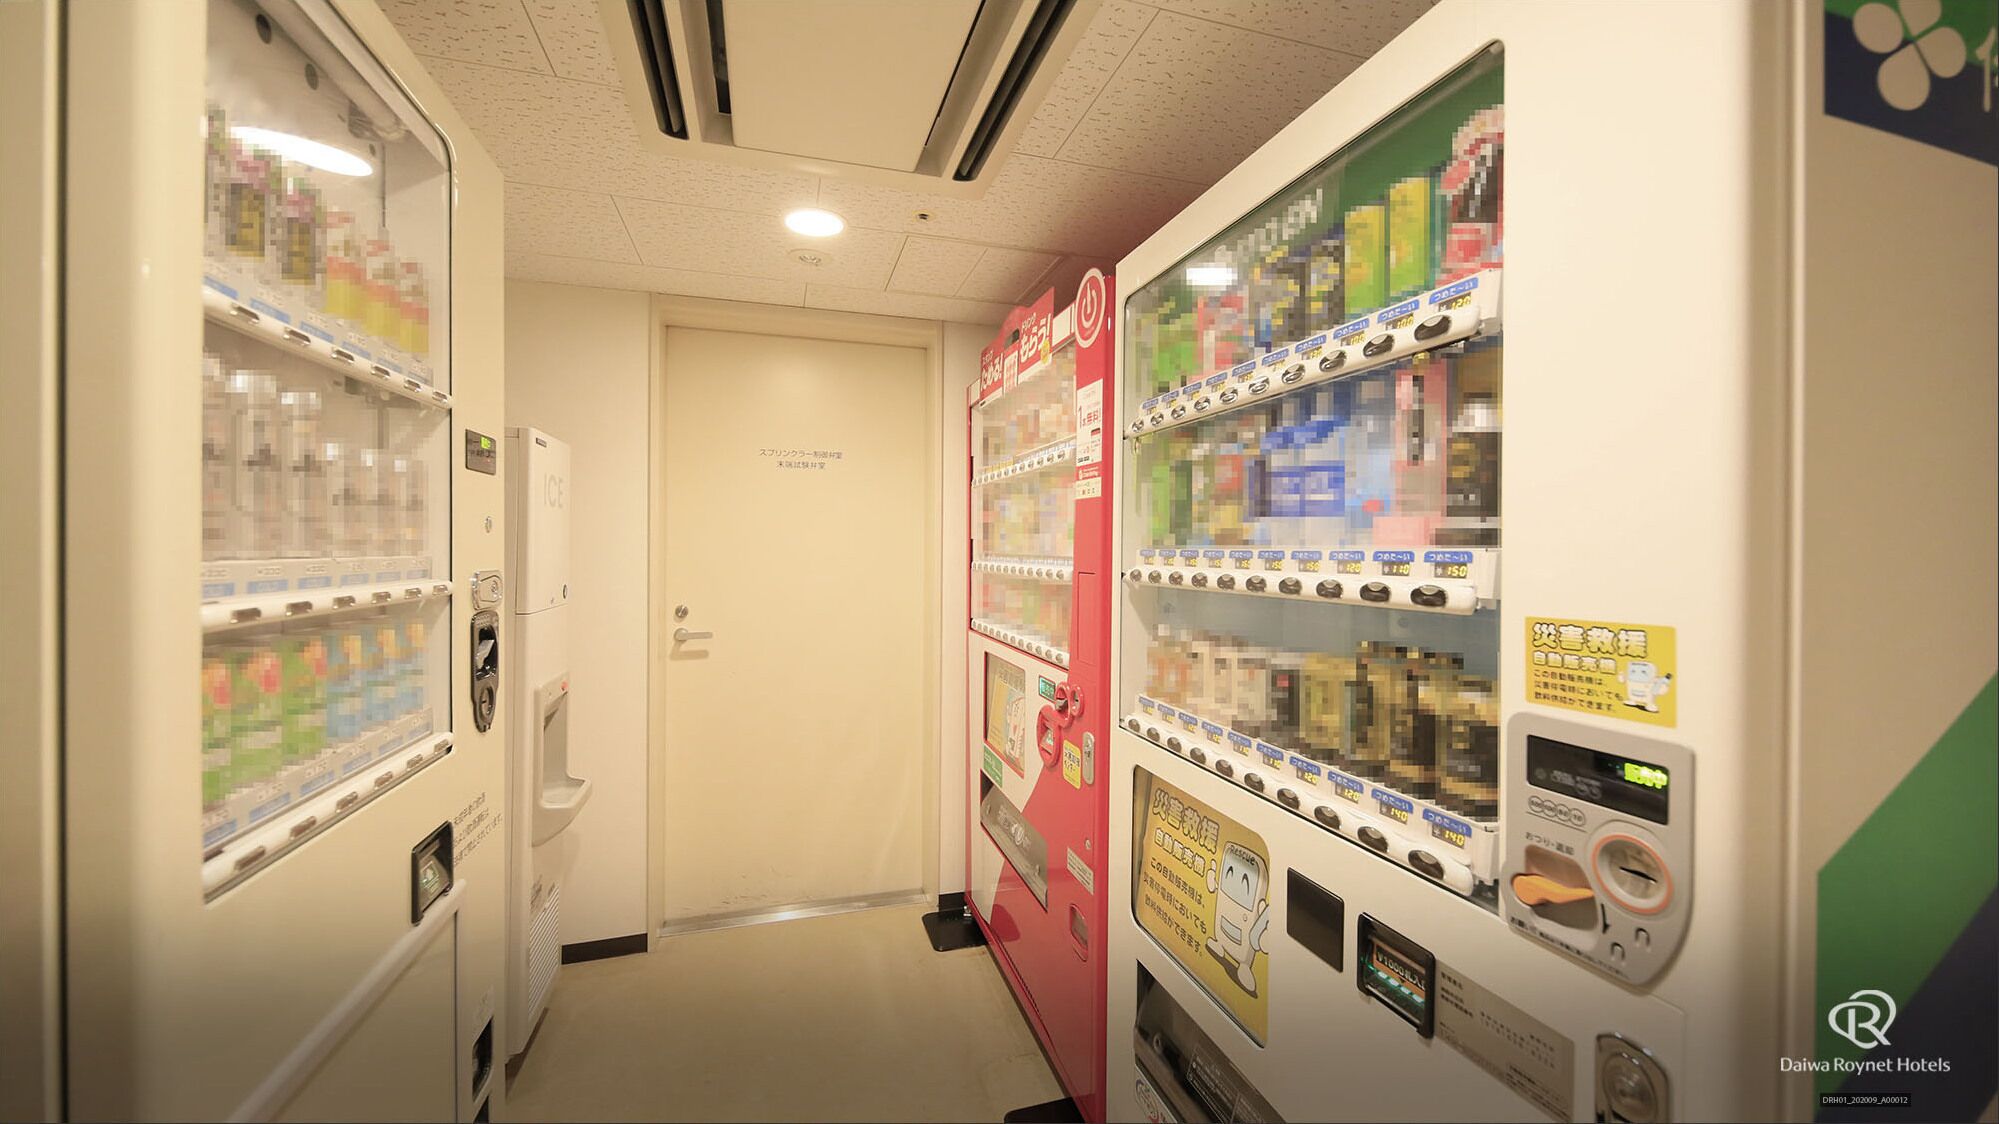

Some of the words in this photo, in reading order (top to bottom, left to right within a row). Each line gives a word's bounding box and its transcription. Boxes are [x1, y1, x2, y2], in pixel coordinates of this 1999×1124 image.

[544, 473, 565, 509] ICE
[1532, 622, 1648, 659] 災害救援
[1532, 650, 1617, 675] 自動販売機
[1152, 787, 1220, 855] 災害救援
[1154, 827, 1205, 877] 自動販売機
